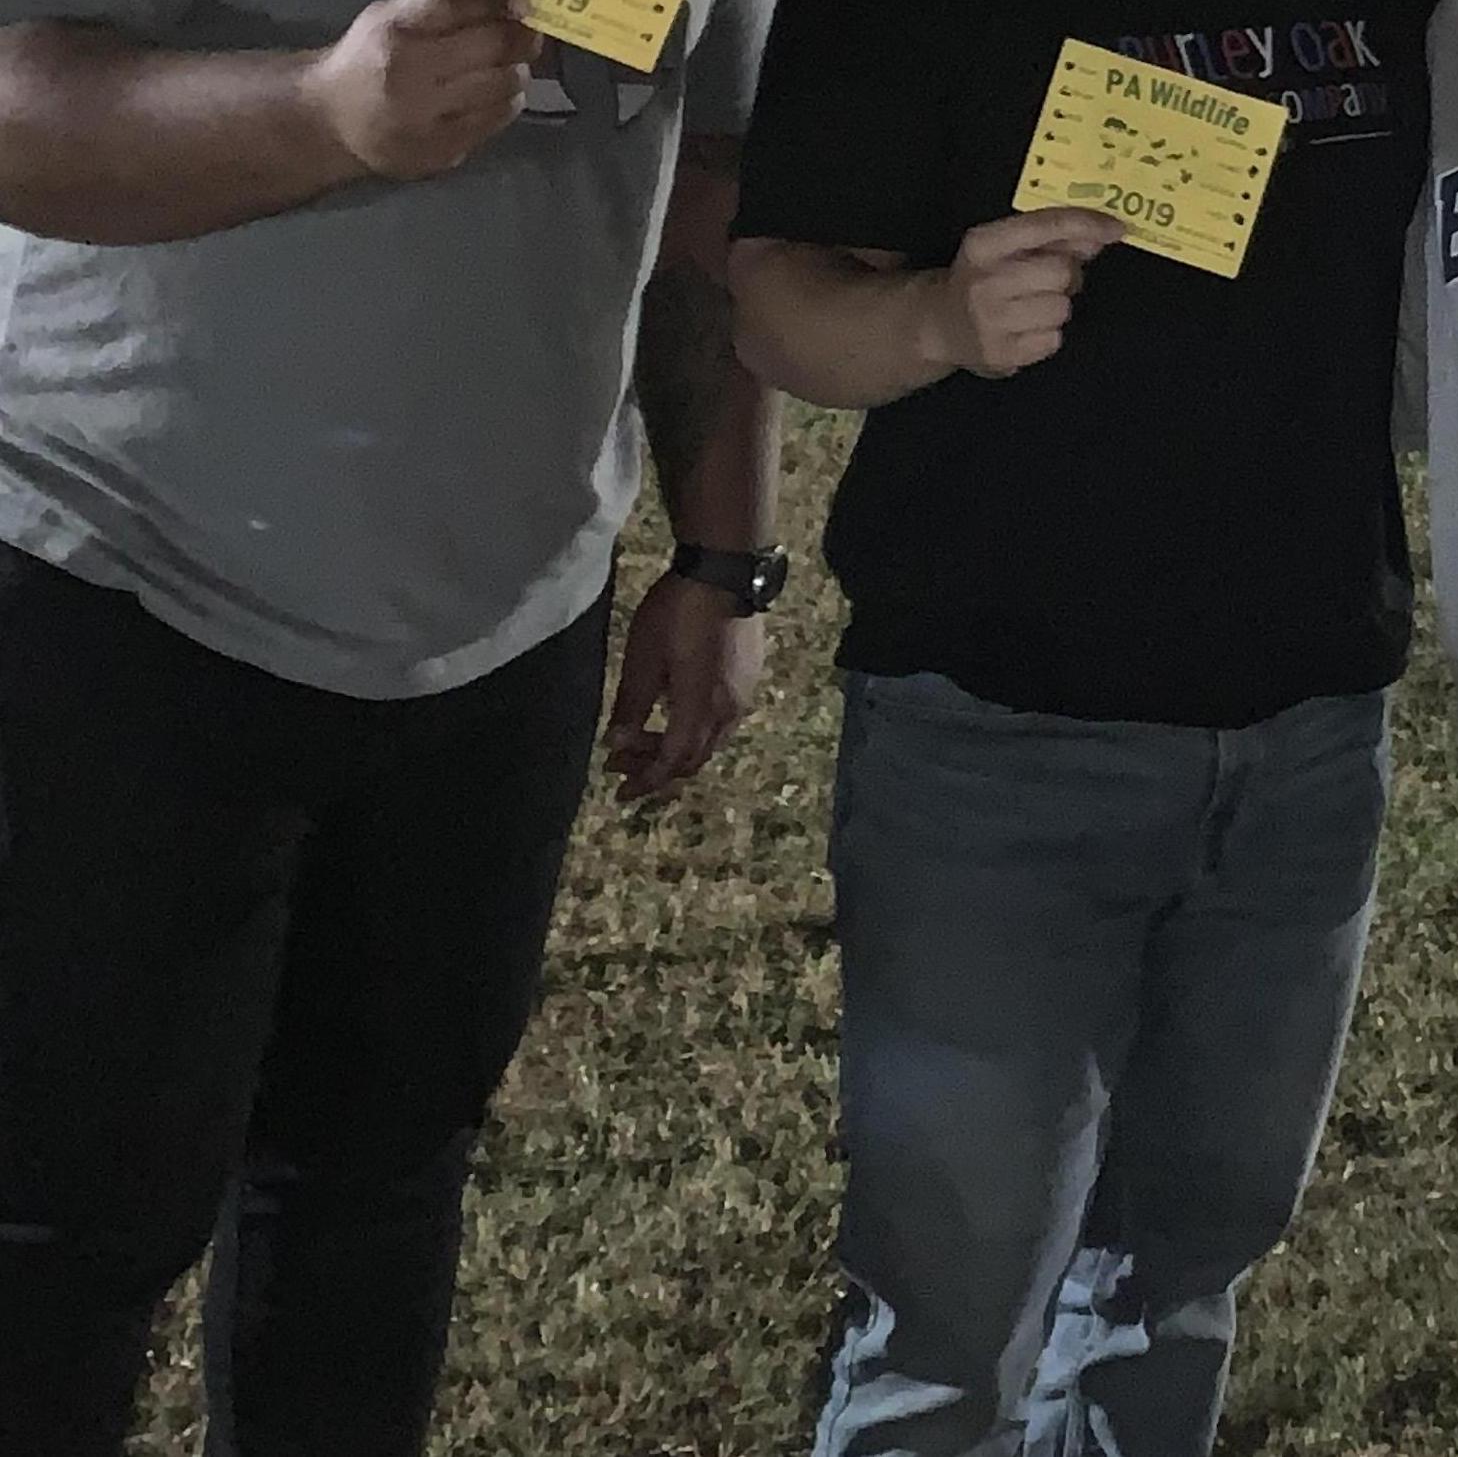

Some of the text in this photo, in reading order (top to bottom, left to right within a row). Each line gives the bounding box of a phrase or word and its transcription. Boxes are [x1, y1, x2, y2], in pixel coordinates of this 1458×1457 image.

[1104, 67, 1252, 137] PA Wildlife
[1102, 183, 1176, 229] 2019
